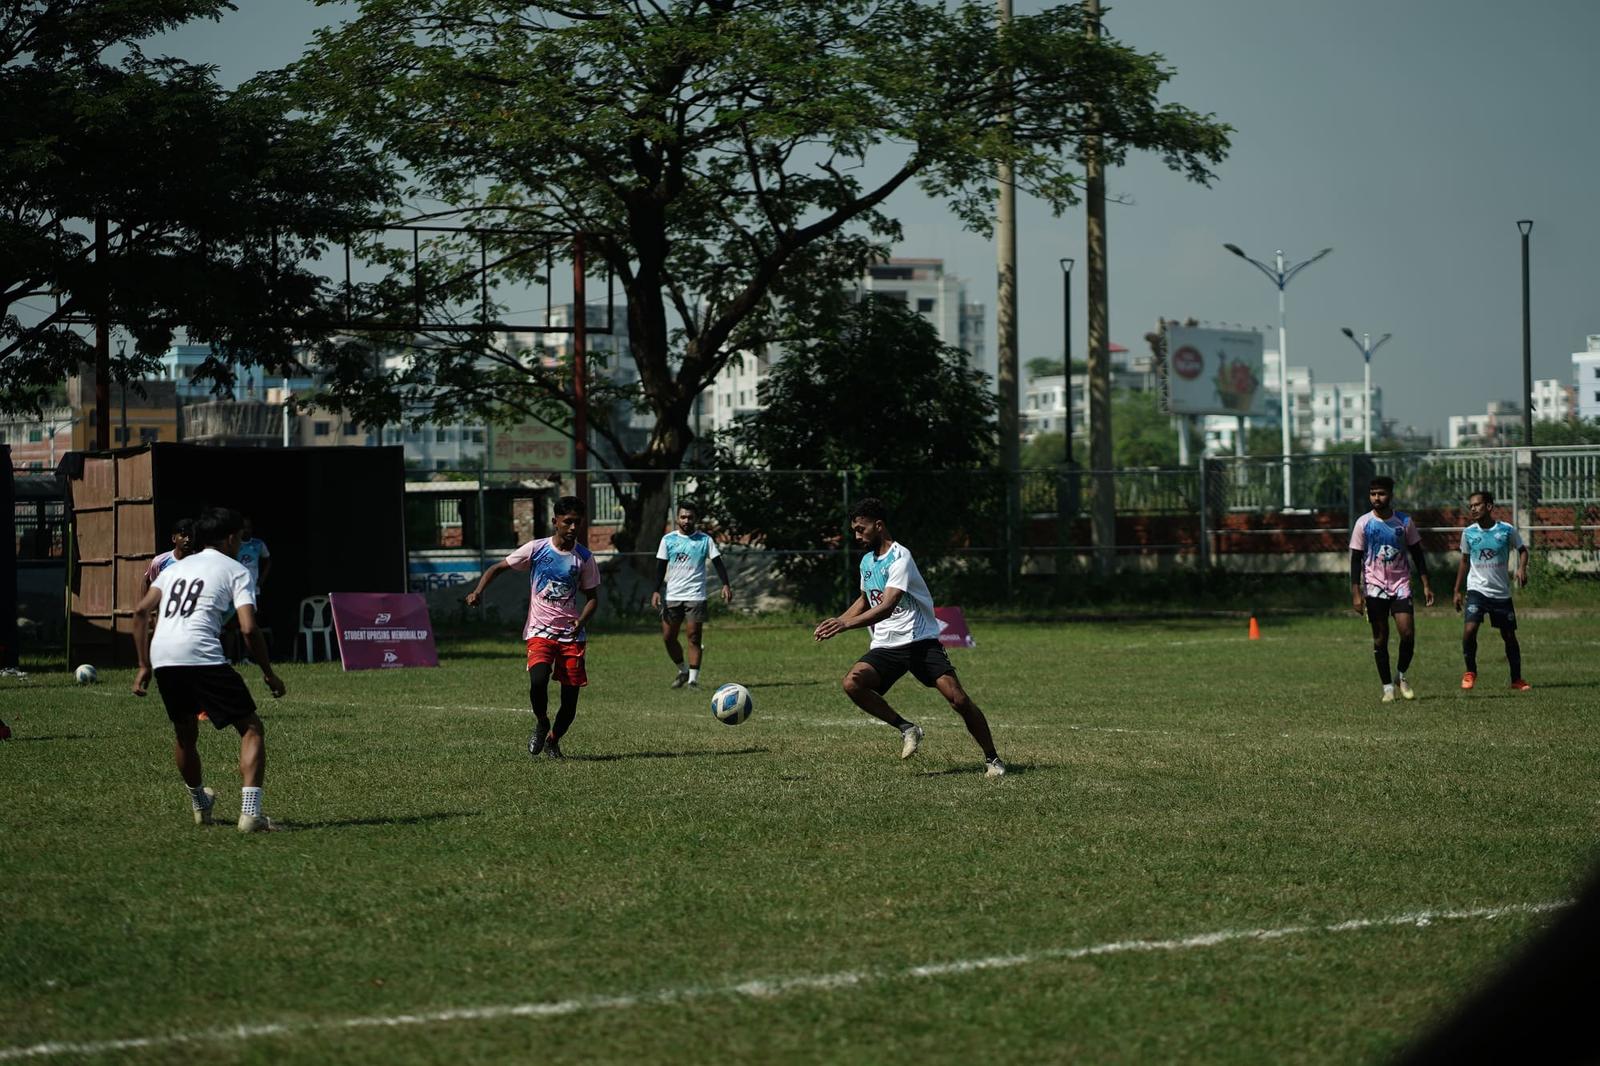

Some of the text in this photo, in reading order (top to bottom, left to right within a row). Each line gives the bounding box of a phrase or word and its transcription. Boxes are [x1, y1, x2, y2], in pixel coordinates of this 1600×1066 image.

[164, 577, 204, 619] 88
[344, 630, 428, 640] STUDENT UPRISING MEMORIAL CUP
